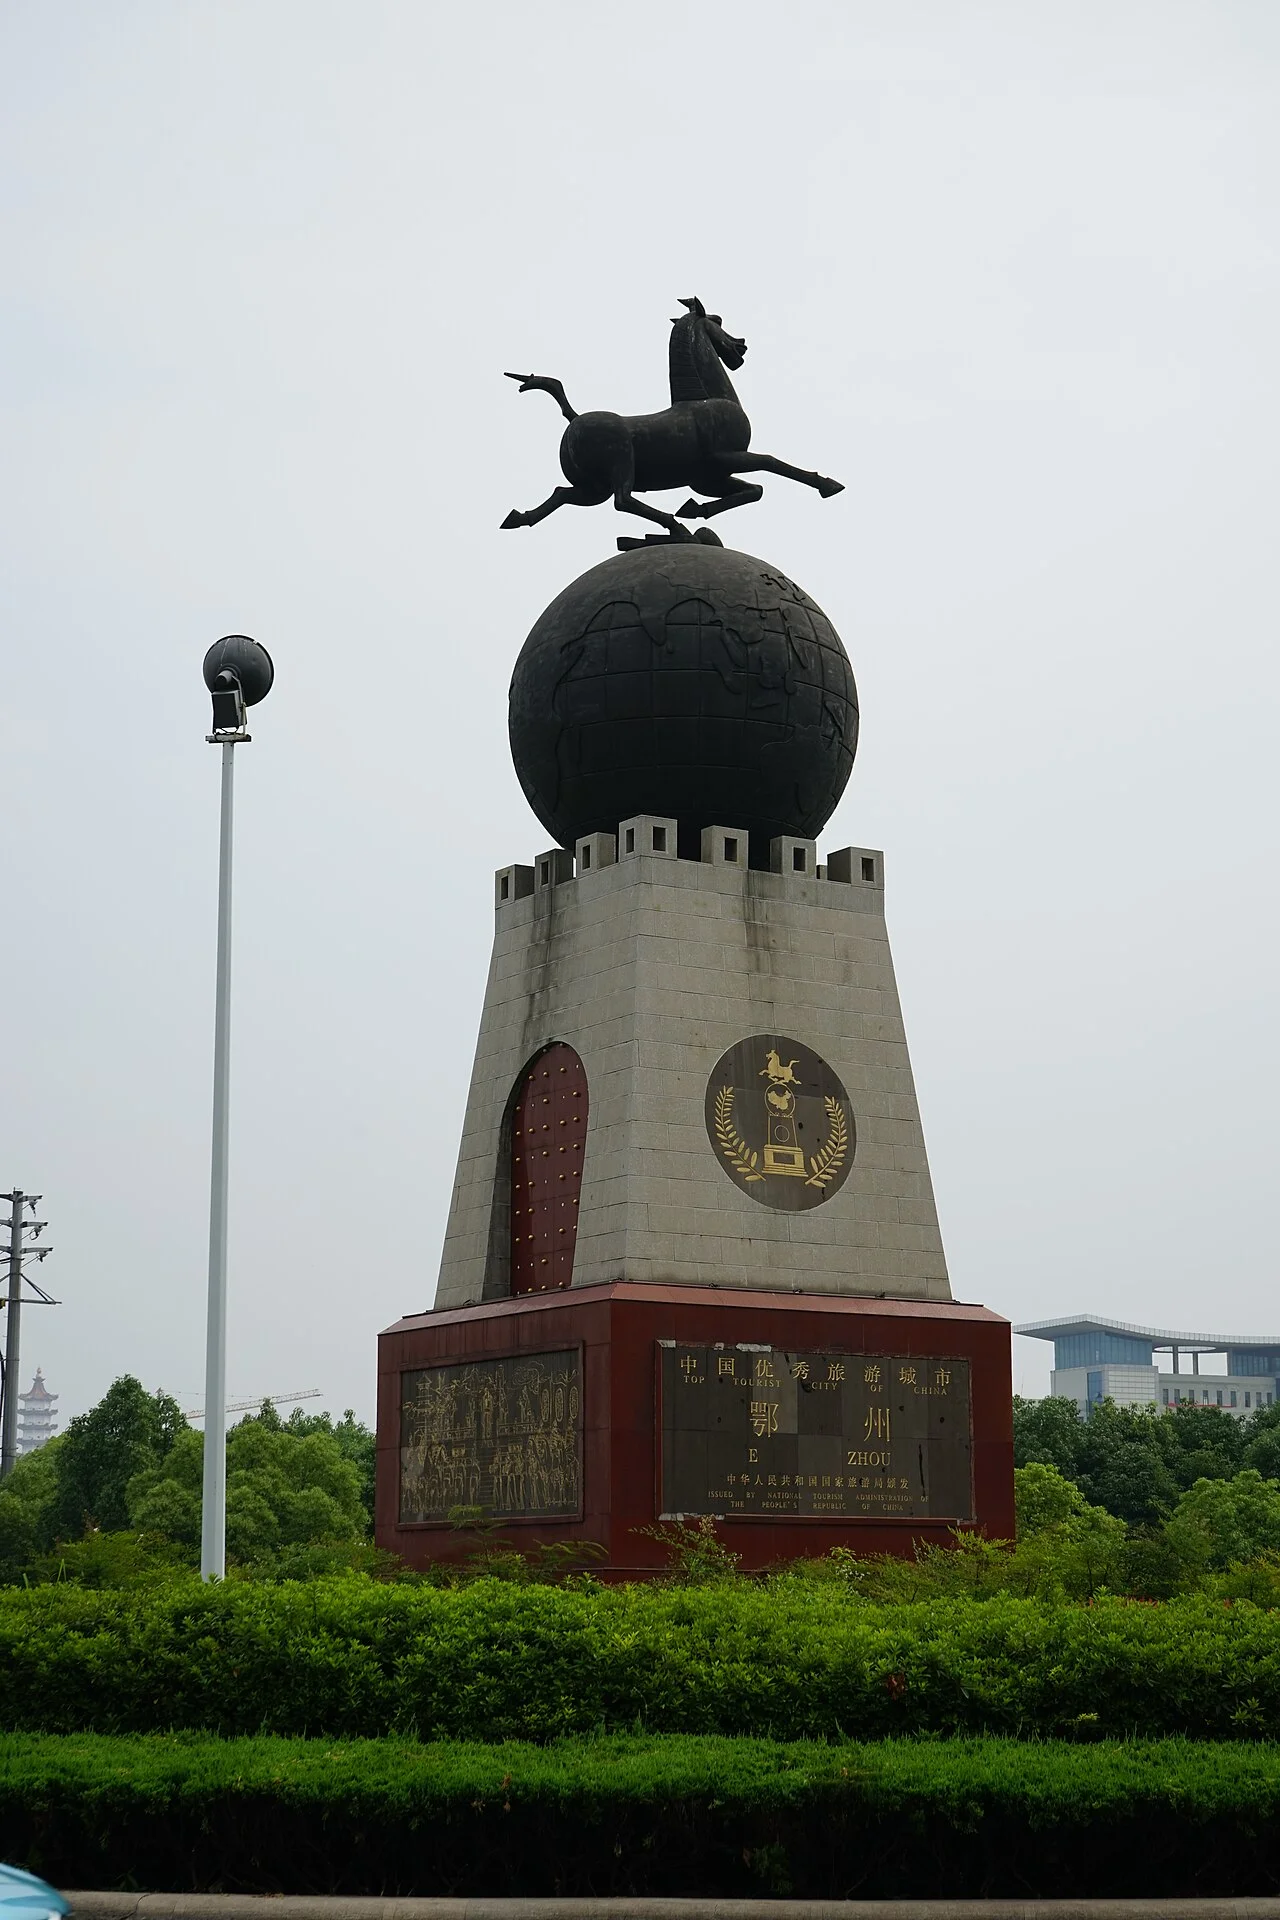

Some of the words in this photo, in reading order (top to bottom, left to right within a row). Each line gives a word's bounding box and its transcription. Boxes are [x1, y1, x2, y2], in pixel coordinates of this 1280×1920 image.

[680, 1355, 951, 1387] 中国优秀旅游城市
[683, 1375, 705, 1384] TOP
[733, 1377, 781, 1388] TOURIST
[811, 1381, 838, 1391] CITY
[870, 1384, 884, 1393] OF
[913, 1386, 947, 1396] CHINA
[749, 1449, 759, 1463] E
[847, 1451, 891, 1466] ZHOU
[727, 1473, 909, 1490] 中华人民共和国国家旅游局颁发
[708, 1490, 734, 1498] ISSUED
[746, 1491, 755, 1499] BY
[767, 1491, 802, 1500] NATIONAL
[812, 1493, 843, 1501] TOURISM
[855, 1494, 914, 1502] ADMINISTRATION
[920, 1495, 929, 1503] OF
[730, 1500, 745, 1508] THE
[812, 1502, 847, 1510] REPUBLIC
[882, 1503, 904, 1511] CHINA
